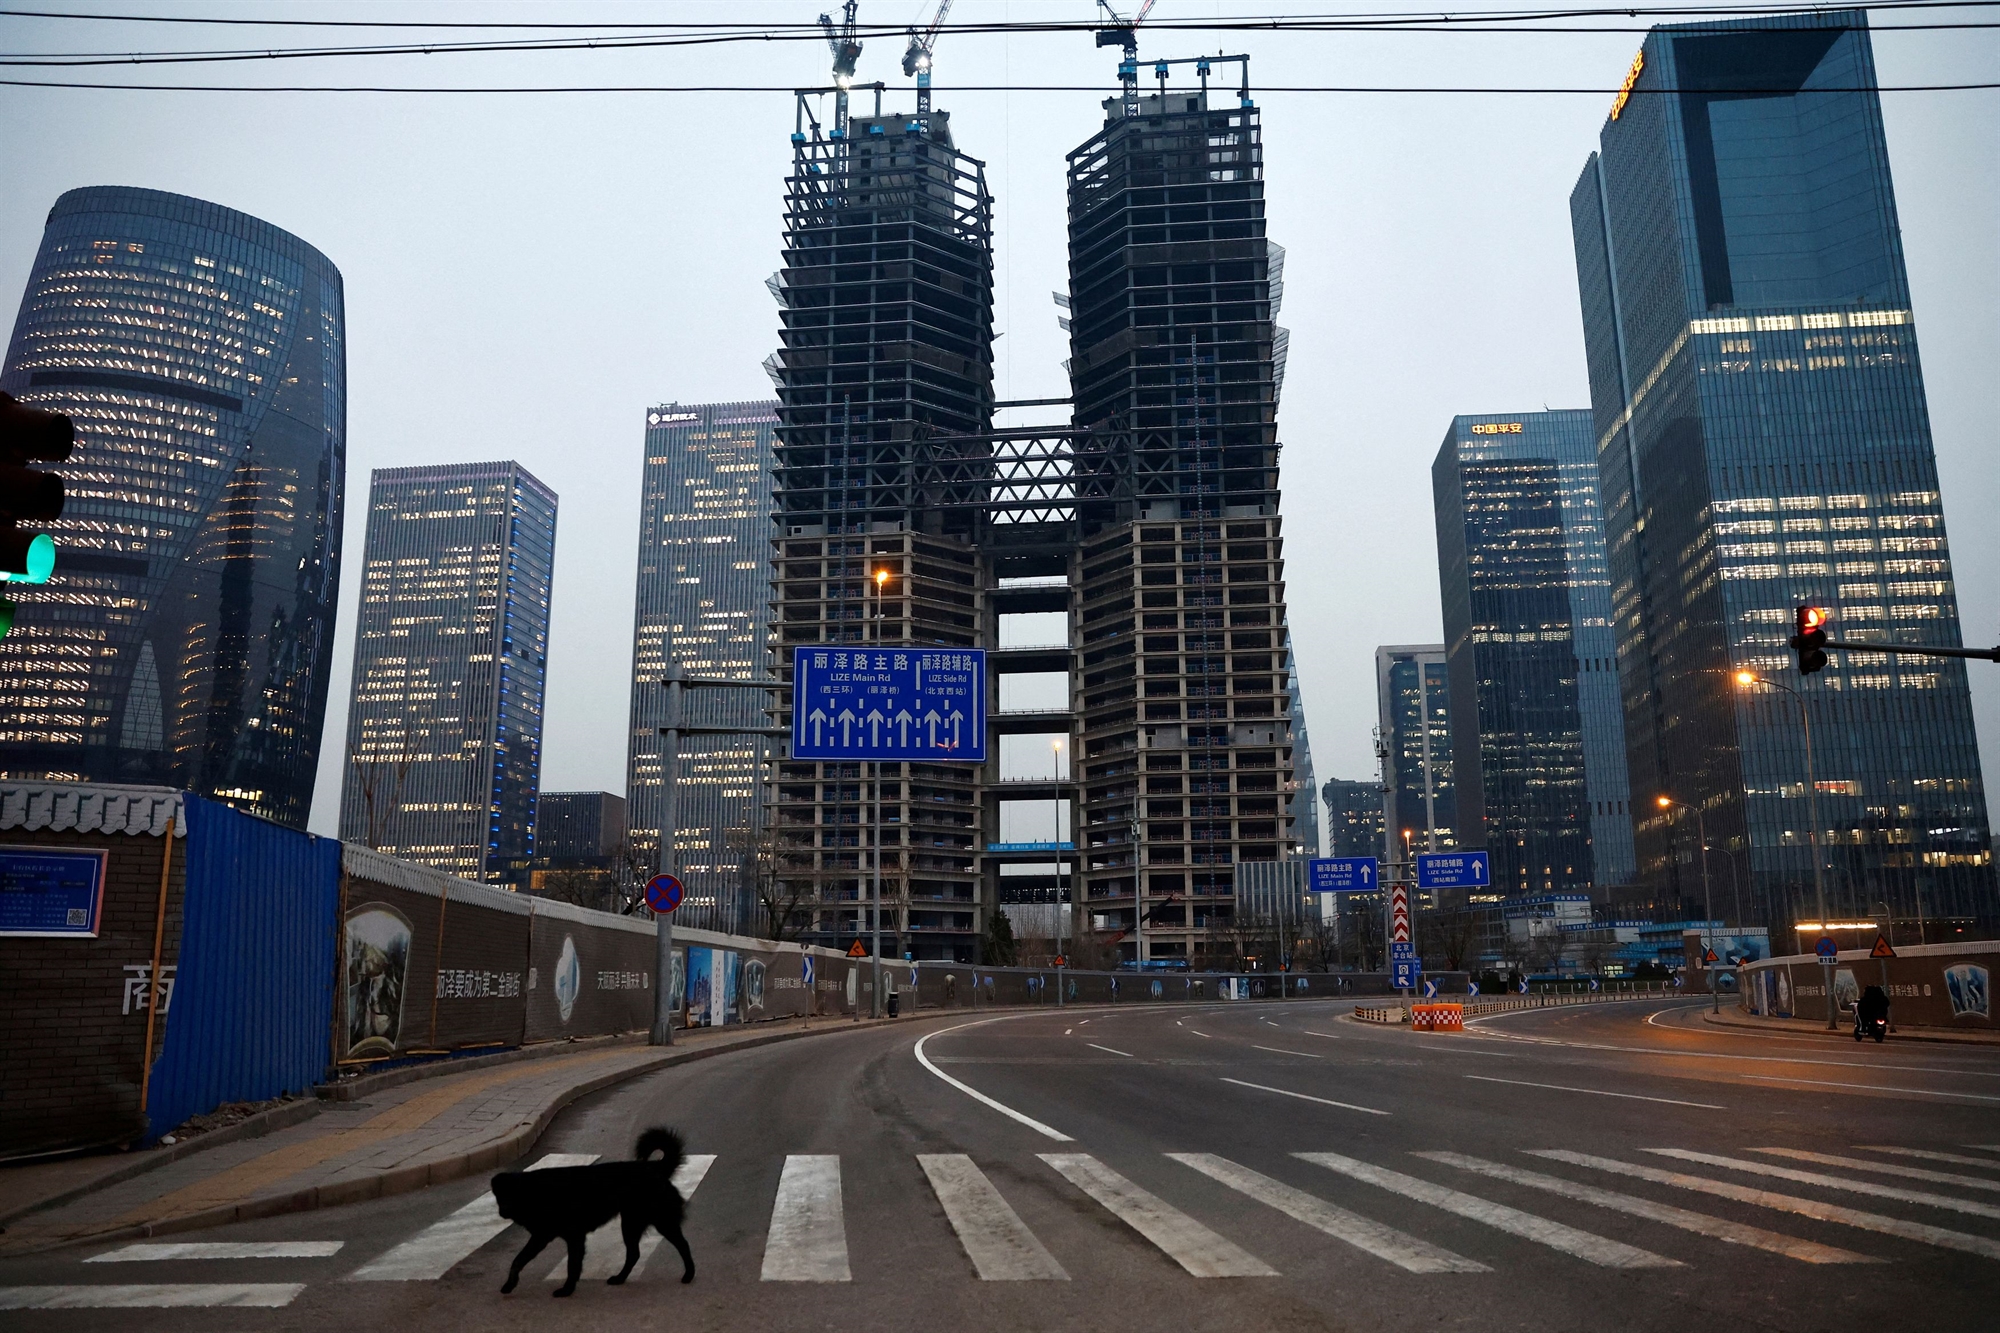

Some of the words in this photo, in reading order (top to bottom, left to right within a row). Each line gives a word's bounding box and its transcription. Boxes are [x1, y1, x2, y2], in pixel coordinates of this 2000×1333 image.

[1472, 423, 1522, 434] 中国平安
[814, 653, 909, 671] 丽泽路主路
[922, 654, 972, 671] 丽泽路辅路
[830, 673, 850, 682] LIZE
[852, 673, 876, 682] Main
[878, 673, 891, 682] Rd
[928, 674, 942, 682] LIZE
[943, 674, 957, 683] Side
[958, 674, 967, 683] Rd
[1316, 863, 1353, 872] 丽泽路主路
[1426, 858, 1464, 868] 丽泽路辅路
[436, 969, 521, 999] 丽泽要成为第二金融街
